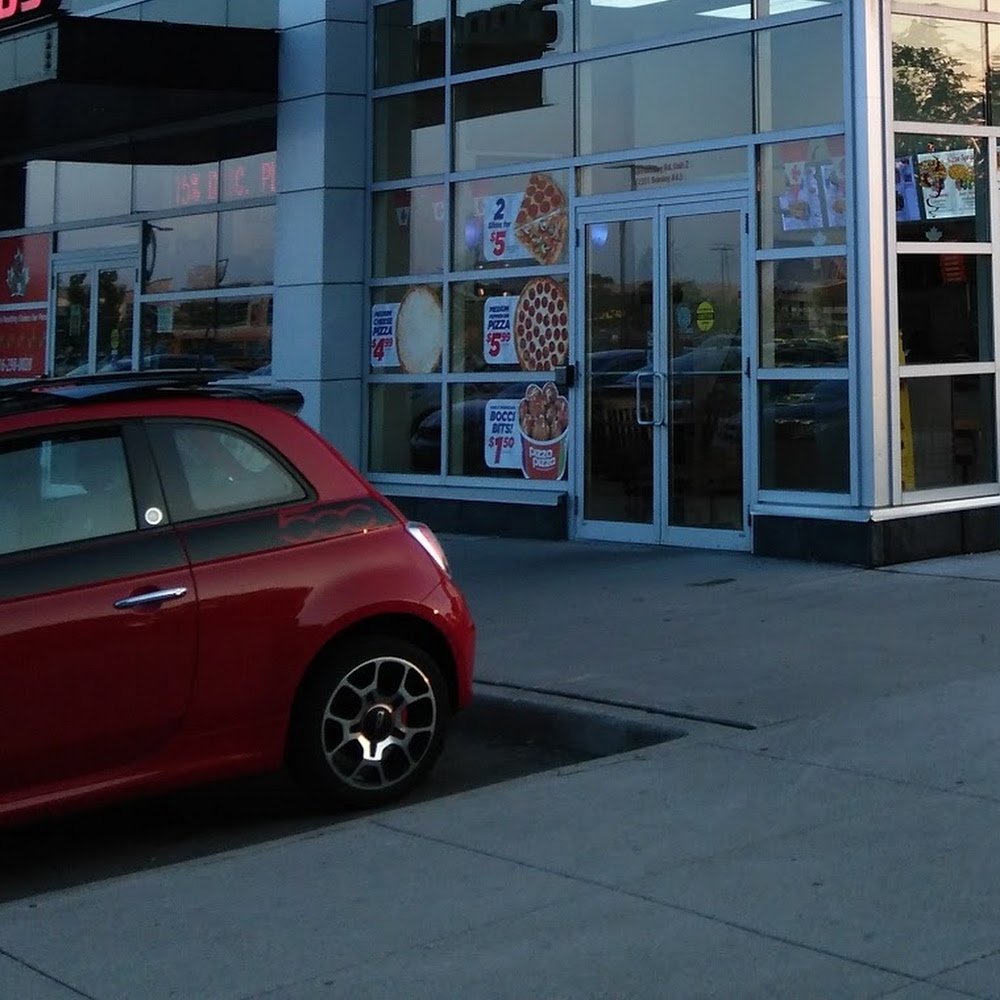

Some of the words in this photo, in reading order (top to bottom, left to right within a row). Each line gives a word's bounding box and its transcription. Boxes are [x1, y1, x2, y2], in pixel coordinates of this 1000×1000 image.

[493, 198, 506, 221] 2
[489, 231, 507, 257] $5
[487, 319, 511, 330] PIZZA
[373, 325, 393, 337] PIZZA
[490, 410, 516, 422] BOCCI
[492, 423, 514, 434] BITS!
[278, 504, 378, 544] 500
